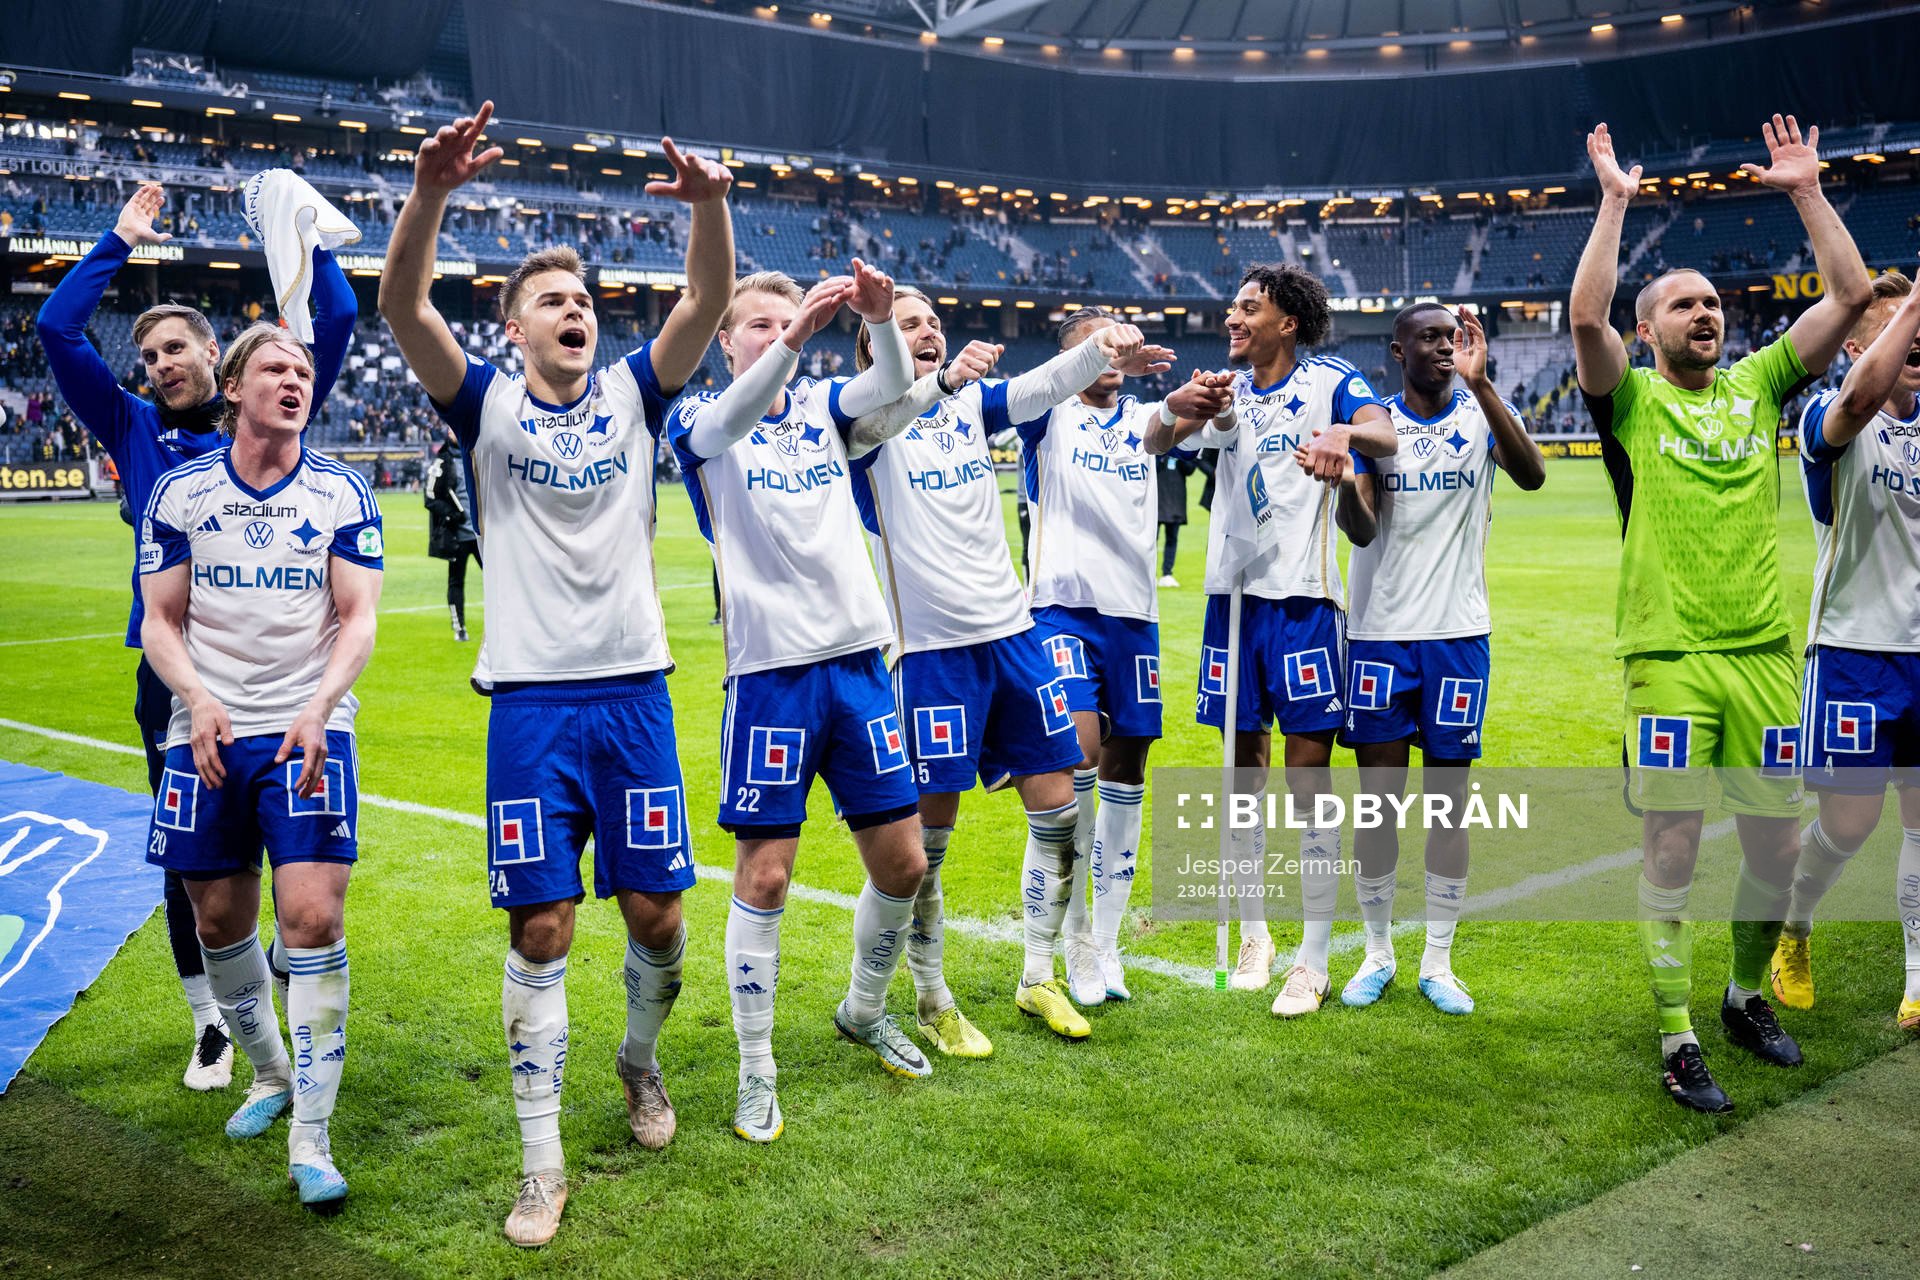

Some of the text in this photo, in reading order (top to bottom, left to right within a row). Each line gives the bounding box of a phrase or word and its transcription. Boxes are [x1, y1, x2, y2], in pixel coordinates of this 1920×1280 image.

[0, 468, 85, 489] ten.se
[508, 451, 628, 491] HOLMEN
[747, 460, 844, 494] HOLMEN
[908, 455, 993, 491] HOLMEN
[222, 502, 298, 518] stadium
[193, 565, 324, 590] HOLMEN
[1824, 755, 1835, 777] 4
[735, 786, 760, 813] 22
[150, 828, 167, 856] 20
[490, 870, 509, 898] 24
[1026, 868, 1046, 901] Ocab
[872, 929, 898, 958] Ocab
[236, 997, 259, 1036] Ocab
[295, 1025, 313, 1069] Ocab
